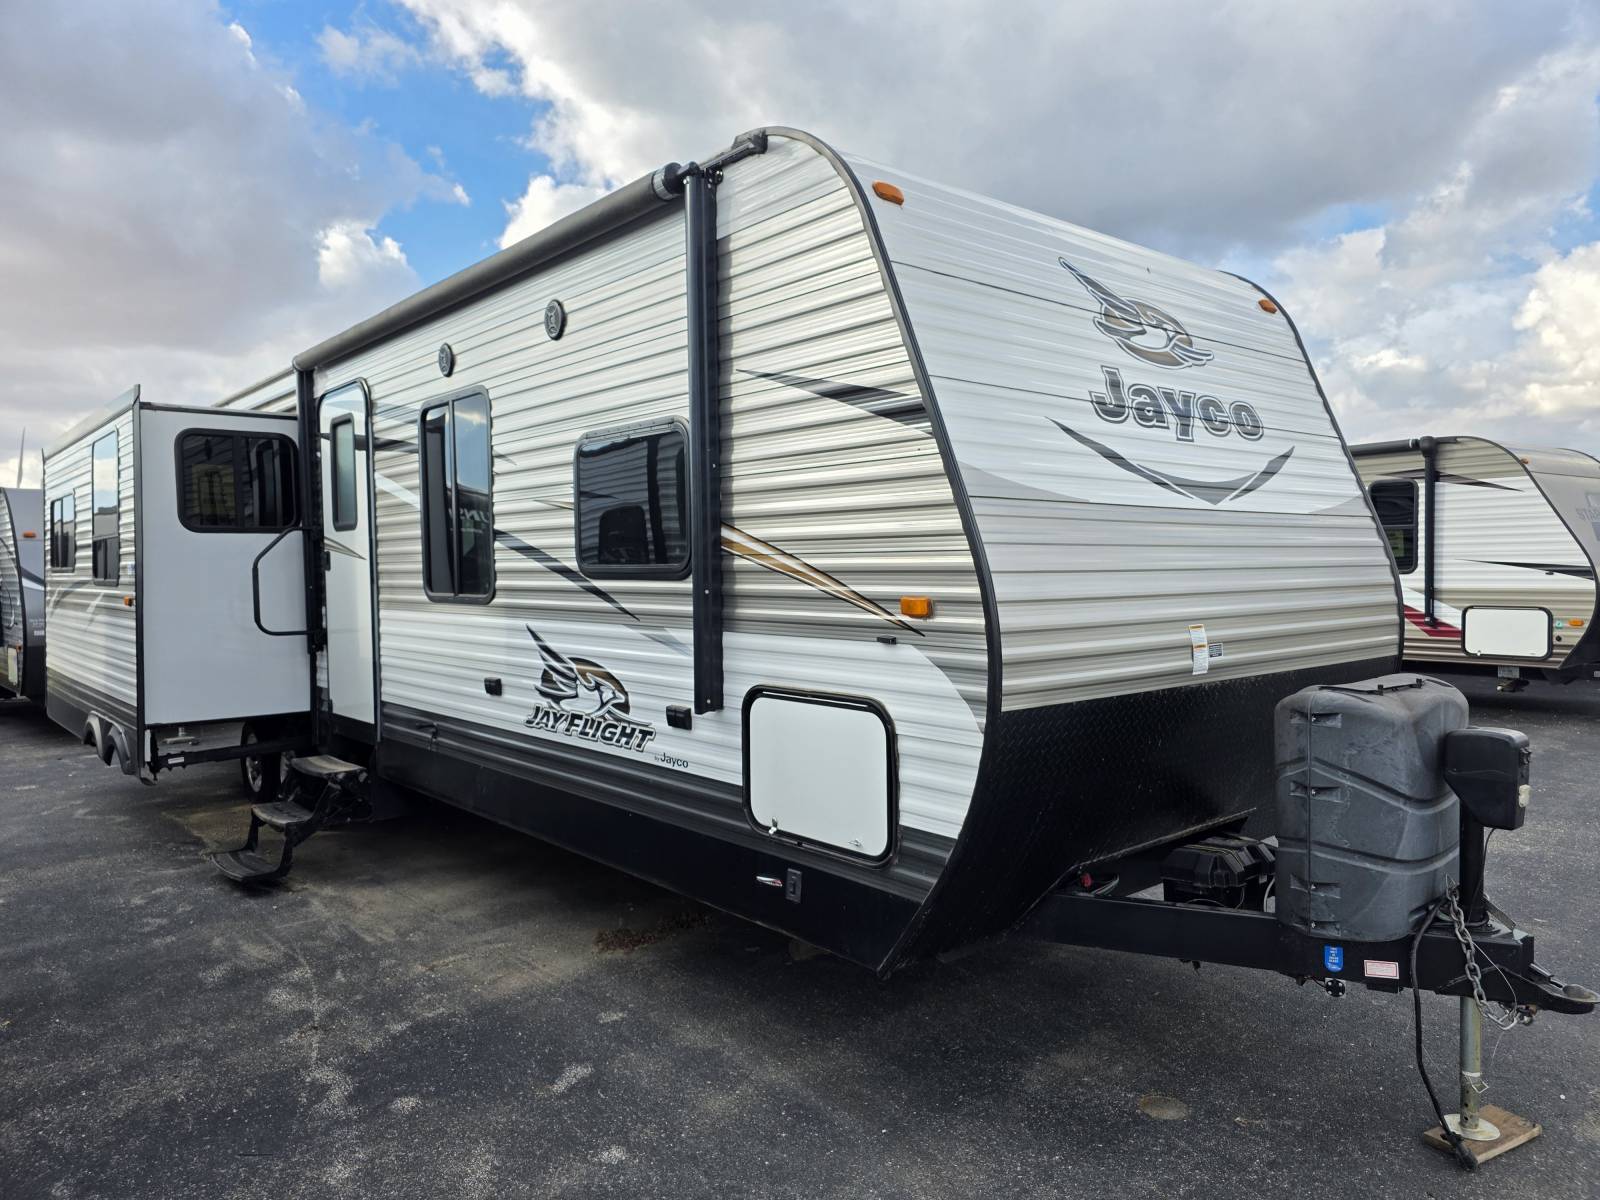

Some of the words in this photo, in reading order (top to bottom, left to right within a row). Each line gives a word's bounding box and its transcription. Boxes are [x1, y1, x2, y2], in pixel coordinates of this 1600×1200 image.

[1088, 365, 1264, 442] Jayco
[525, 704, 568, 733] JAY
[564, 710, 656, 752] FLIGHT
[660, 752, 689, 768] Jayco
